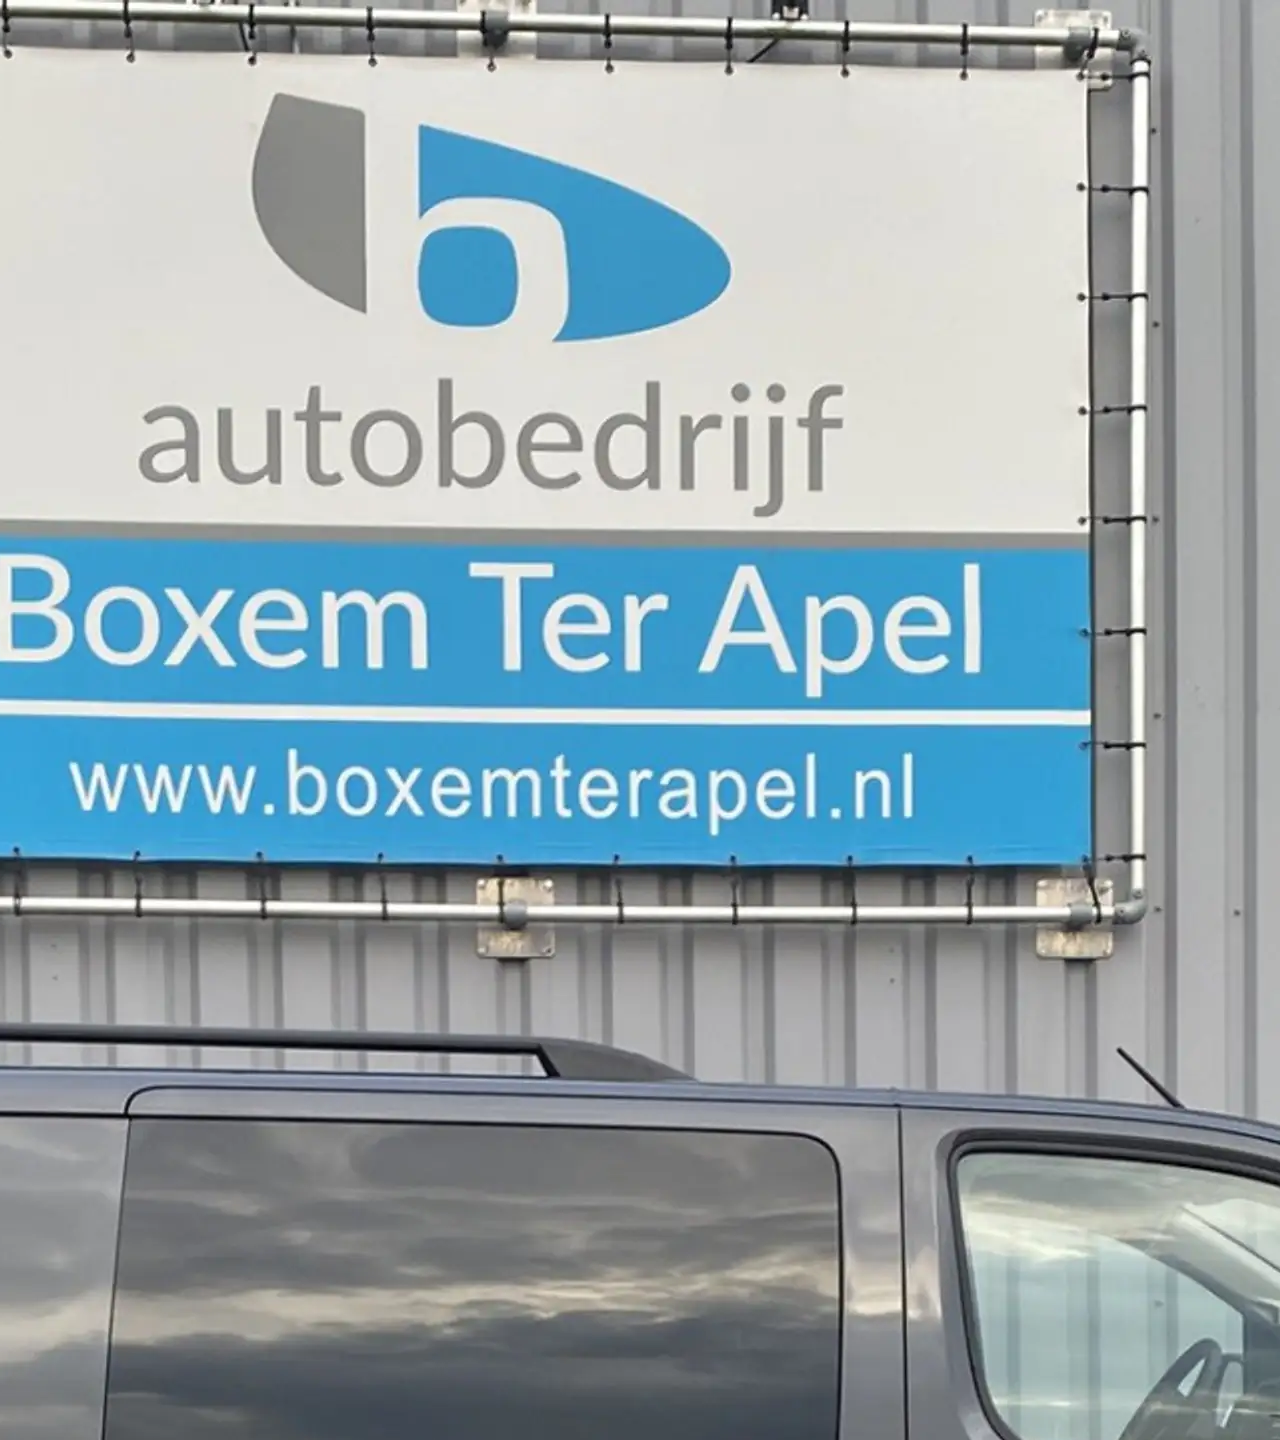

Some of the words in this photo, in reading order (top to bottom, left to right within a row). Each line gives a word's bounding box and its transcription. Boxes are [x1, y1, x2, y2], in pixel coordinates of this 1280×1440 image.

[137, 377, 845, 519] autobedrijf
[468, 561, 670, 674] Ter
[699, 562, 982, 699] Apel
[68, 747, 915, 837] www.boxemterapel.nl
